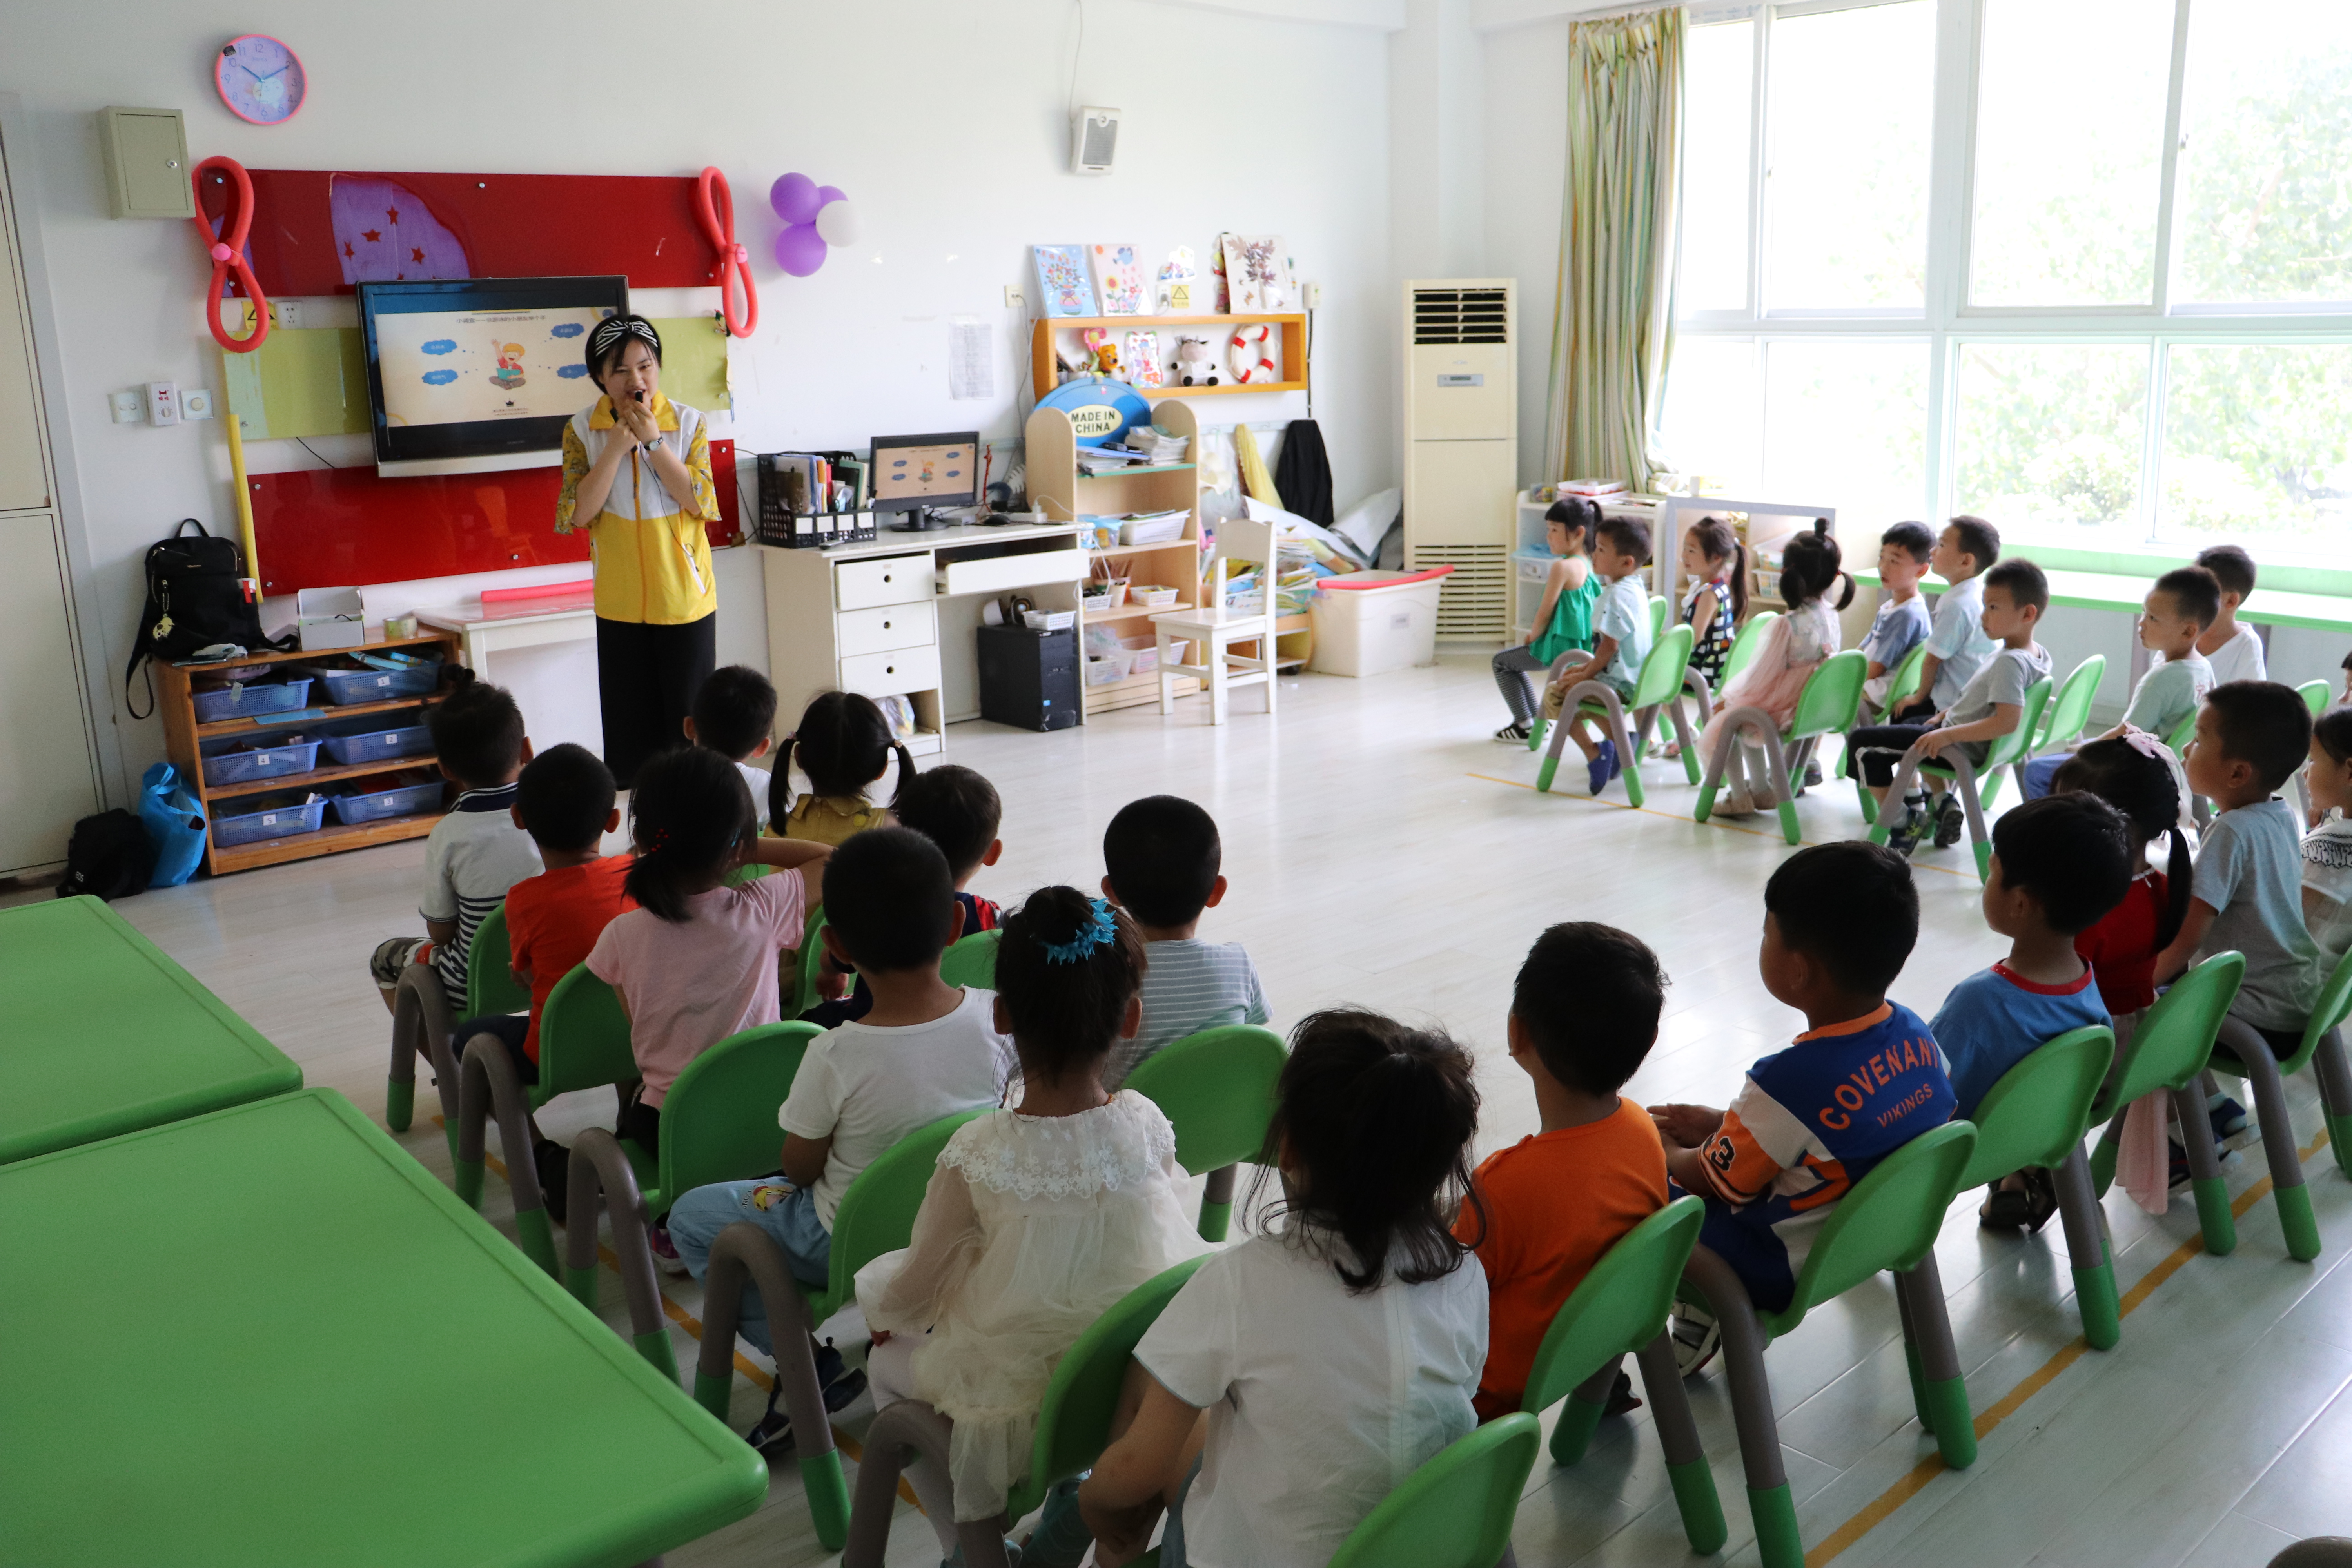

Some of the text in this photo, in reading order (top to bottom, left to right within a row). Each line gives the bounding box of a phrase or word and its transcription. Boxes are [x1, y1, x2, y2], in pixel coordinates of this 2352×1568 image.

[254, 44, 263, 53] 12
[1071, 410, 1116, 422] MADE IN
[1075, 422, 1110, 433] CHINA
[76, 871, 84, 882] EOS
[1819, 1037, 1938, 1130] COVENANT
[1877, 1083, 1933, 1128] VIKINGS
